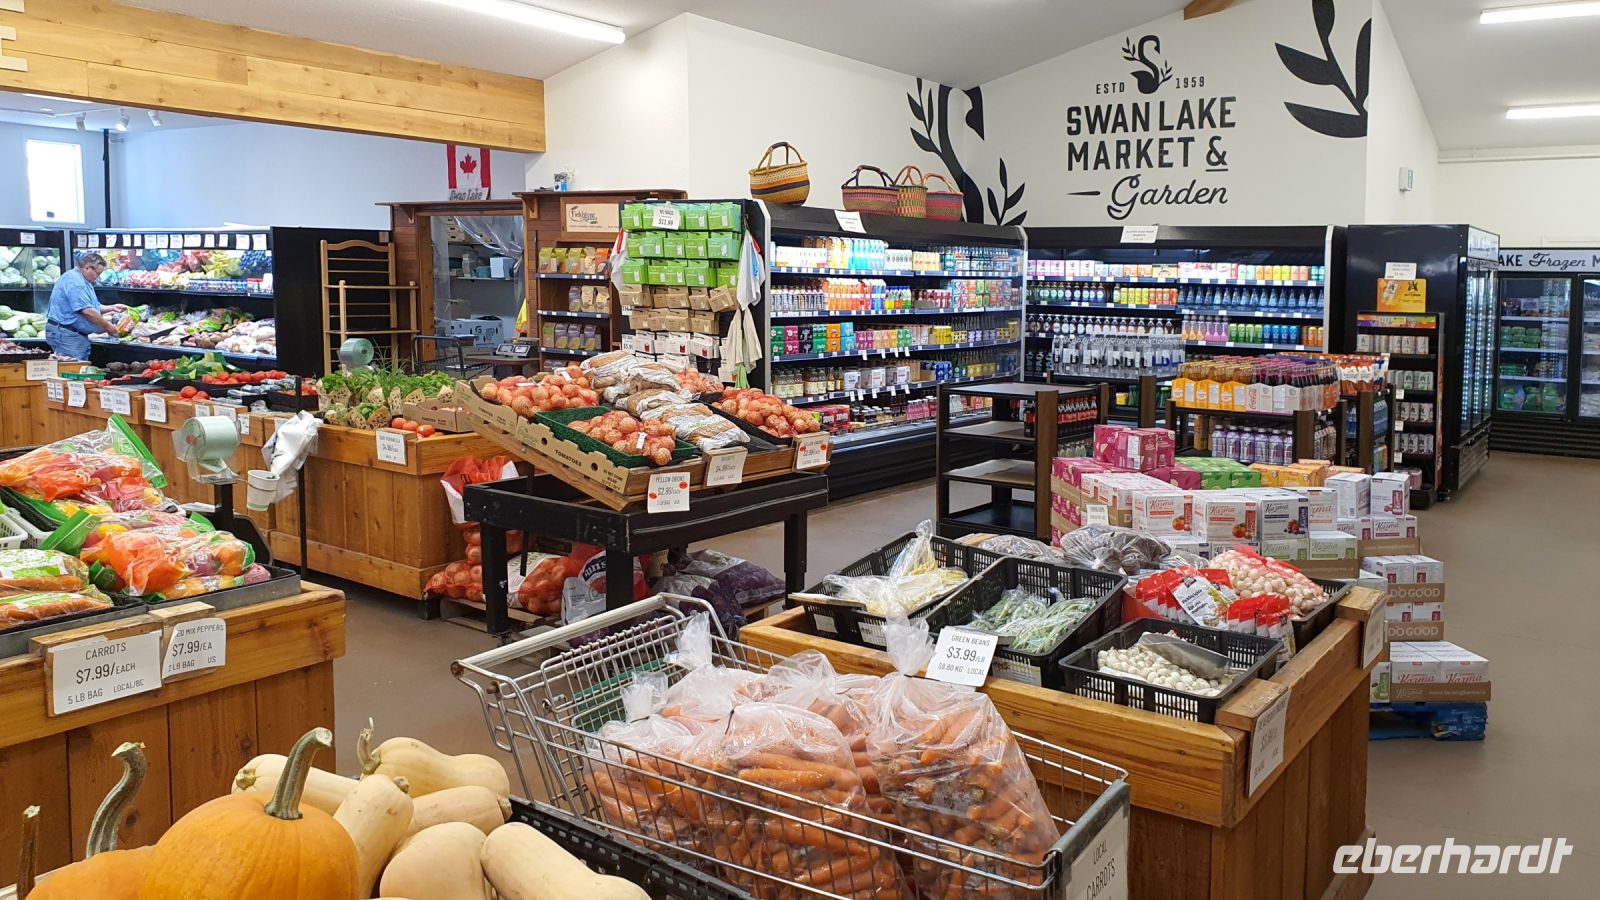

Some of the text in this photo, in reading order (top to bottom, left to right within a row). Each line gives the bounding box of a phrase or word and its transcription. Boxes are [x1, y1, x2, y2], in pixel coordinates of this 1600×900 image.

[1096, 76, 1205, 94] ESTD 1959
[1066, 96, 1236, 136] SWAN LAKE
[1067, 135, 1228, 171] MARKET &
[1107, 173, 1229, 221] Garden
[1498, 254, 1523, 267] AKE
[1528, 252, 1586, 270] Frozen
[554, 449, 582, 468] TOMATOES
[185, 628, 196, 636] MIX
[196, 624, 225, 633] PEPPERS
[172, 640, 213, 658] $7.99/EA
[951, 634, 991, 647] GREEN BEANS
[85, 642, 127, 661] CARROTS
[946, 646, 986, 663] $3.99/LB
[172, 662, 181, 671] LB
[182, 660, 195, 669] BAG
[207, 655, 217, 664] US
[954, 665, 964, 673] KG
[967, 667, 985, 676] LOCAL
[76, 662, 136, 685] $7.99/EACH
[68, 678, 145, 705] 5 LB BAG LOCAL/BC
[1093, 840, 1108, 865] LOCAL
[1086, 857, 1116, 900] CARROTS
